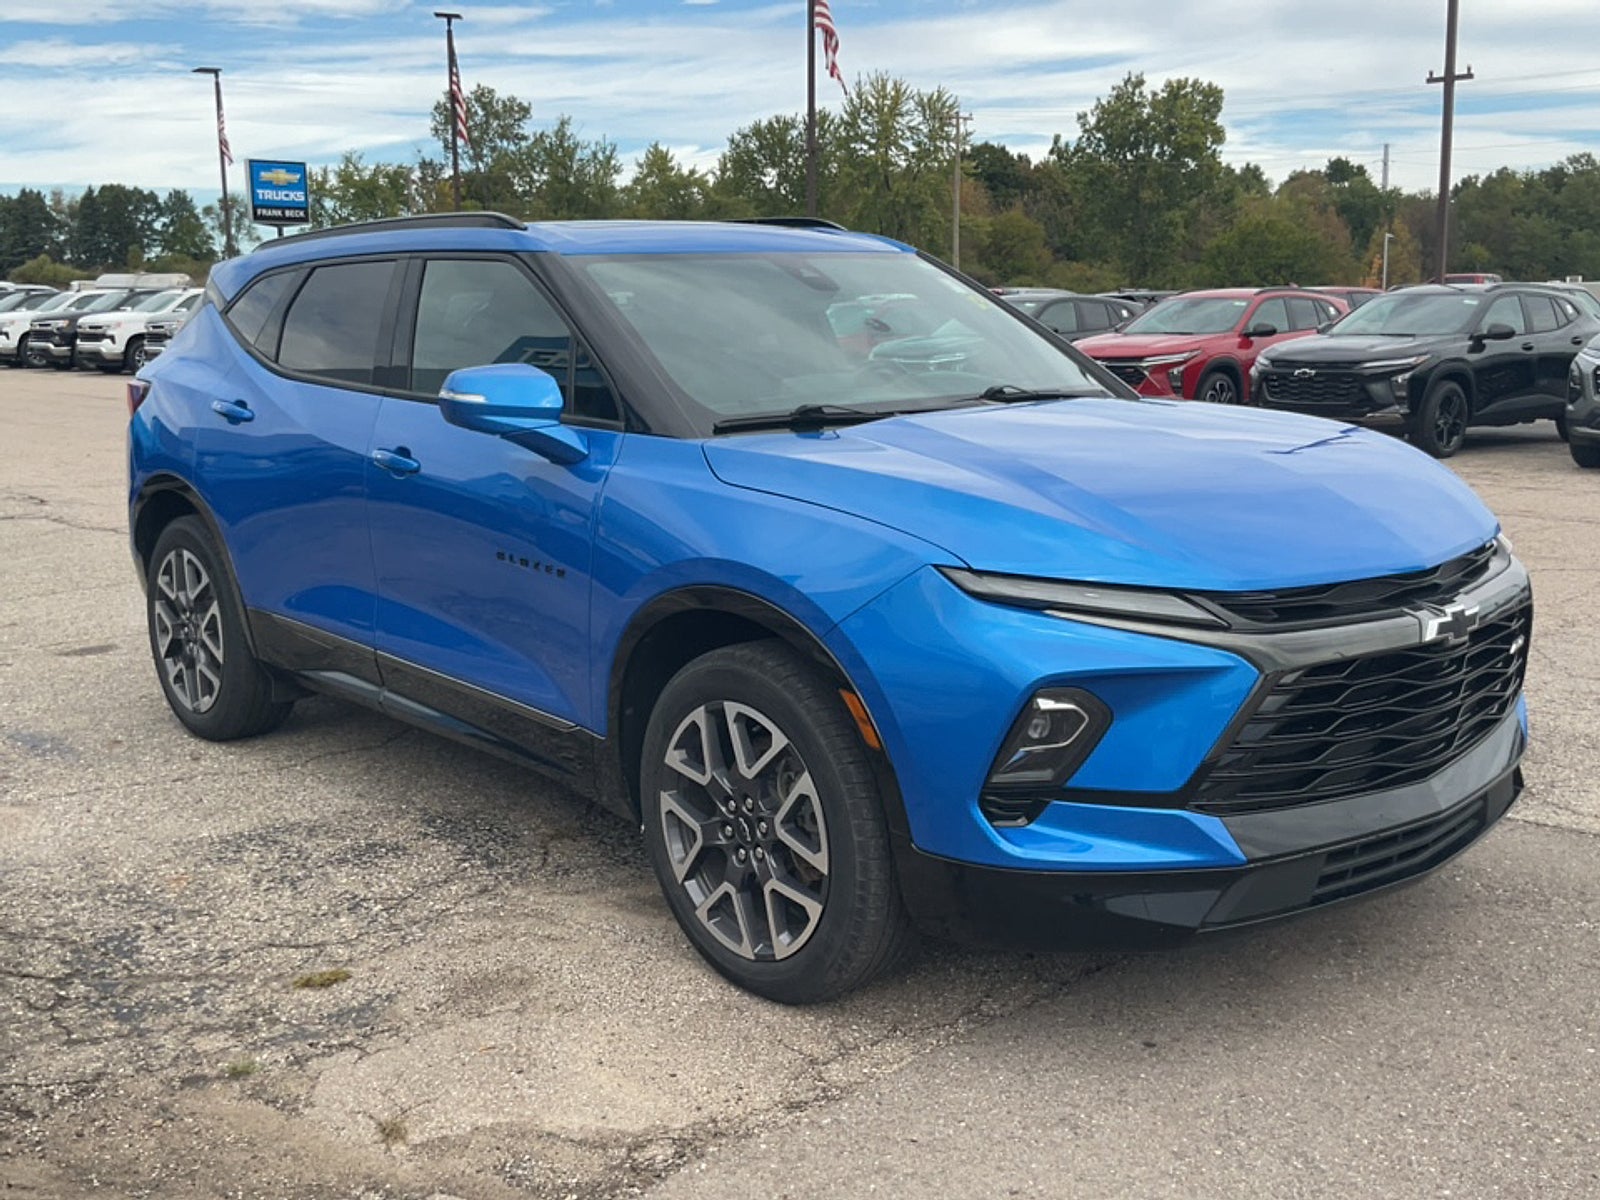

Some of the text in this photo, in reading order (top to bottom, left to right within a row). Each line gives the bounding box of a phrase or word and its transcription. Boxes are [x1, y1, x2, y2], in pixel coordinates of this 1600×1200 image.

[256, 189, 305, 202] TRUCKS
[256, 208, 306, 218] FRANK BECK
[496, 551, 566, 578] BLAZER
